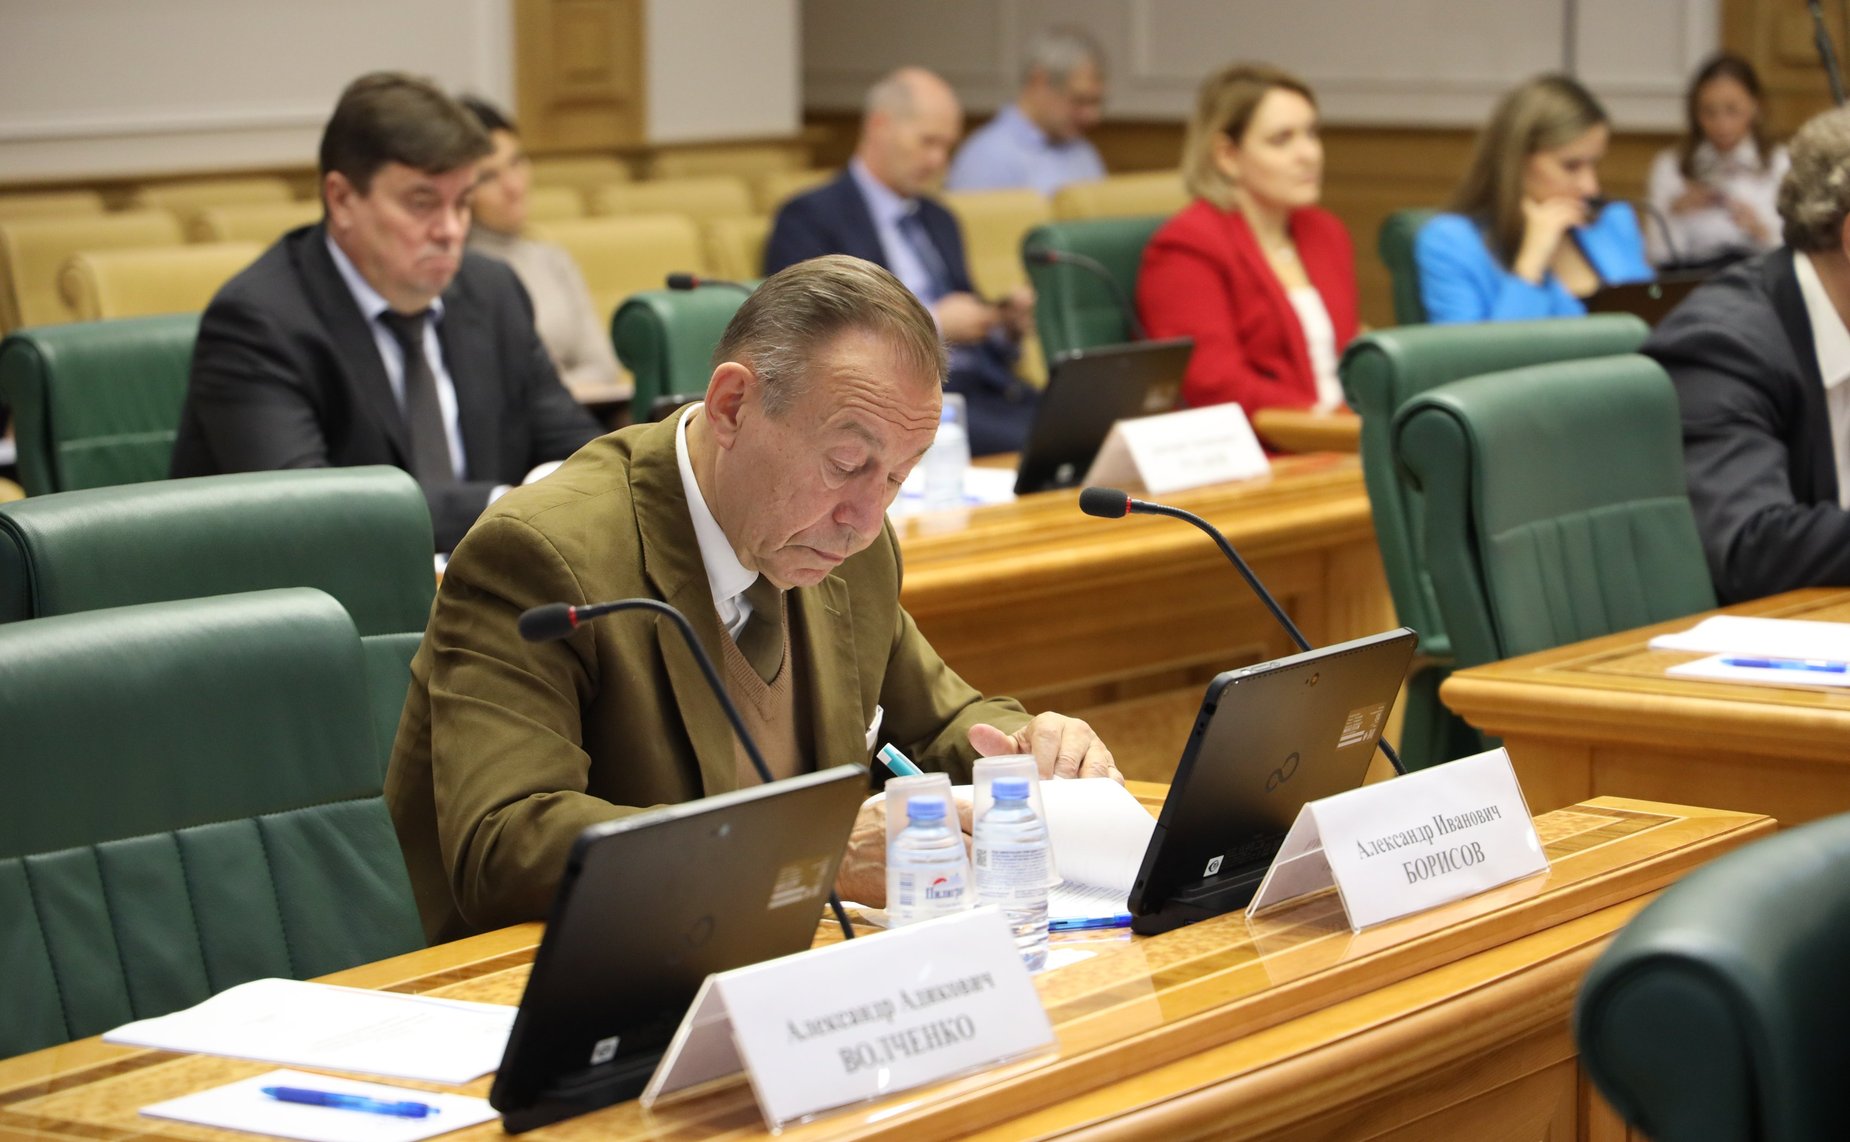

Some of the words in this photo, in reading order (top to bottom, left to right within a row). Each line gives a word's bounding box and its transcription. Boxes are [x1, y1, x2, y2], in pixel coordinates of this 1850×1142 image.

[1356, 823, 1434, 860] Александр
[1432, 805, 1502, 836] Иванович
[1402, 841, 1486, 885] БОРИСОВ
[786, 998, 896, 1044] Александр
[838, 1013, 977, 1075] ВОЛЧЕНКО
